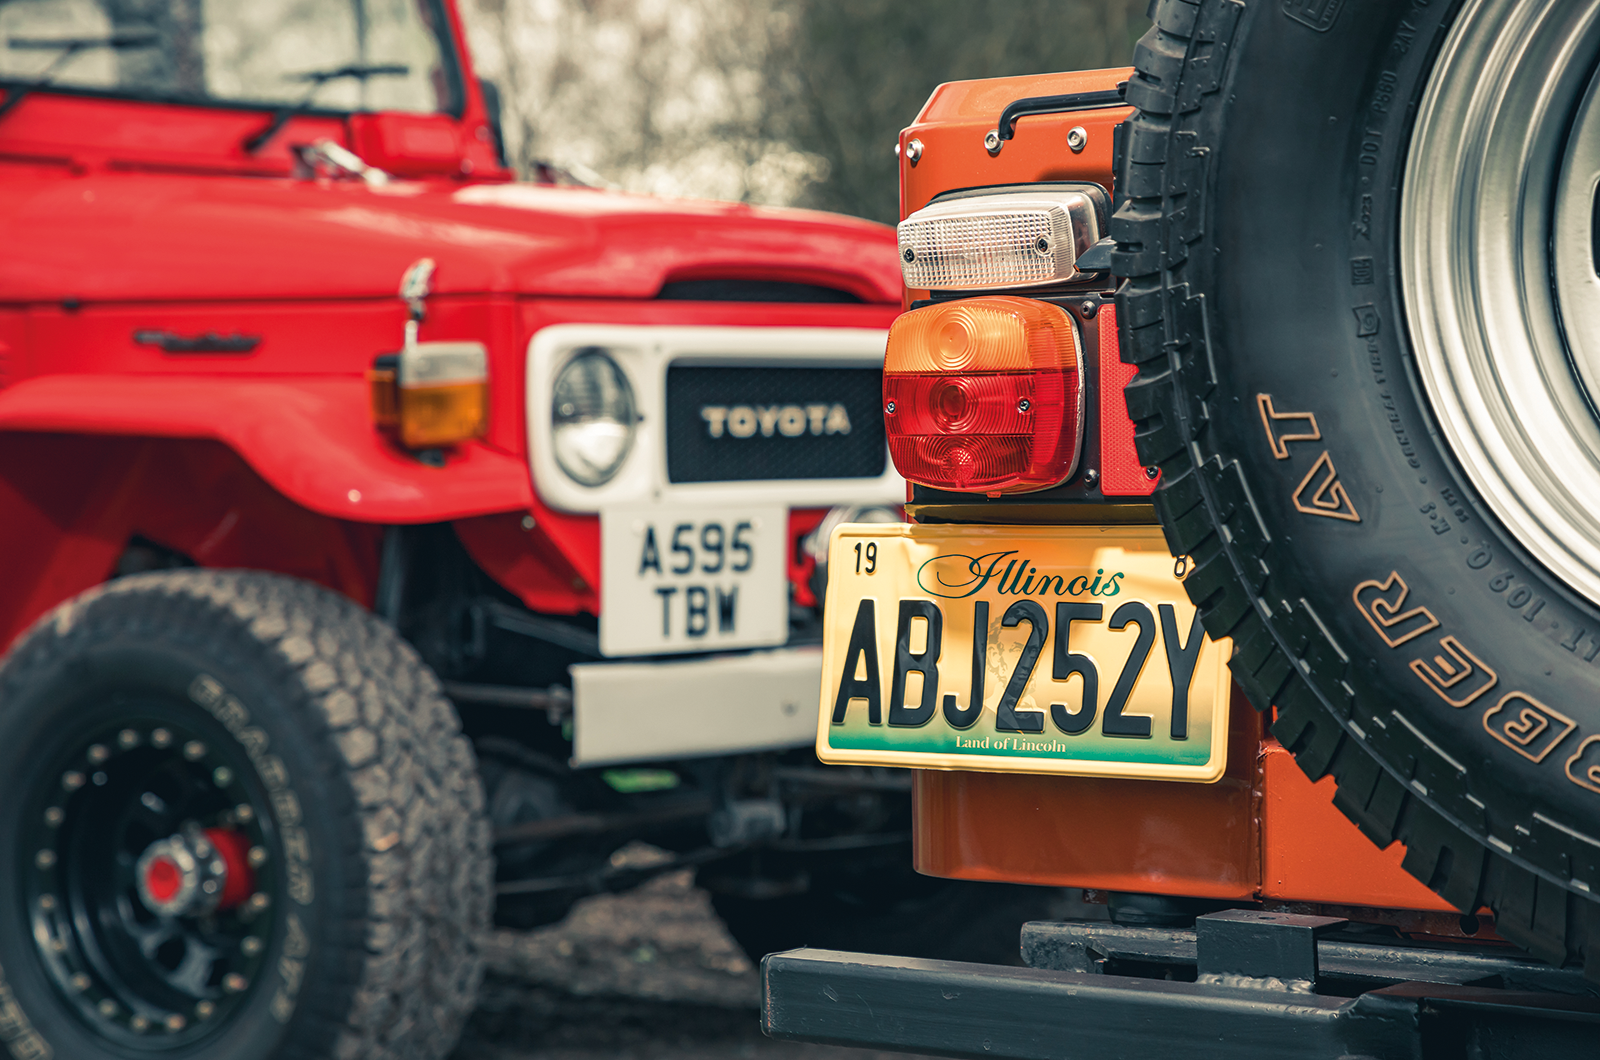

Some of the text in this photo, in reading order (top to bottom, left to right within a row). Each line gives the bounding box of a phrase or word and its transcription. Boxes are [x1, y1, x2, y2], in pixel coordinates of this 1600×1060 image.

[1360, 126, 1382, 164] DOT
[701, 404, 850, 438] TOYOTA
[1256, 393, 1361, 522] AT
[638, 521, 755, 577] A595
[854, 542, 878, 574] 19
[917, 550, 1125, 599] Illinois
[1489, 570, 1544, 621] 109
[654, 584, 739, 639] TBW
[832, 599, 1205, 739] ABJ252Y
[955, 735, 1067, 753] Land of Lincoln
